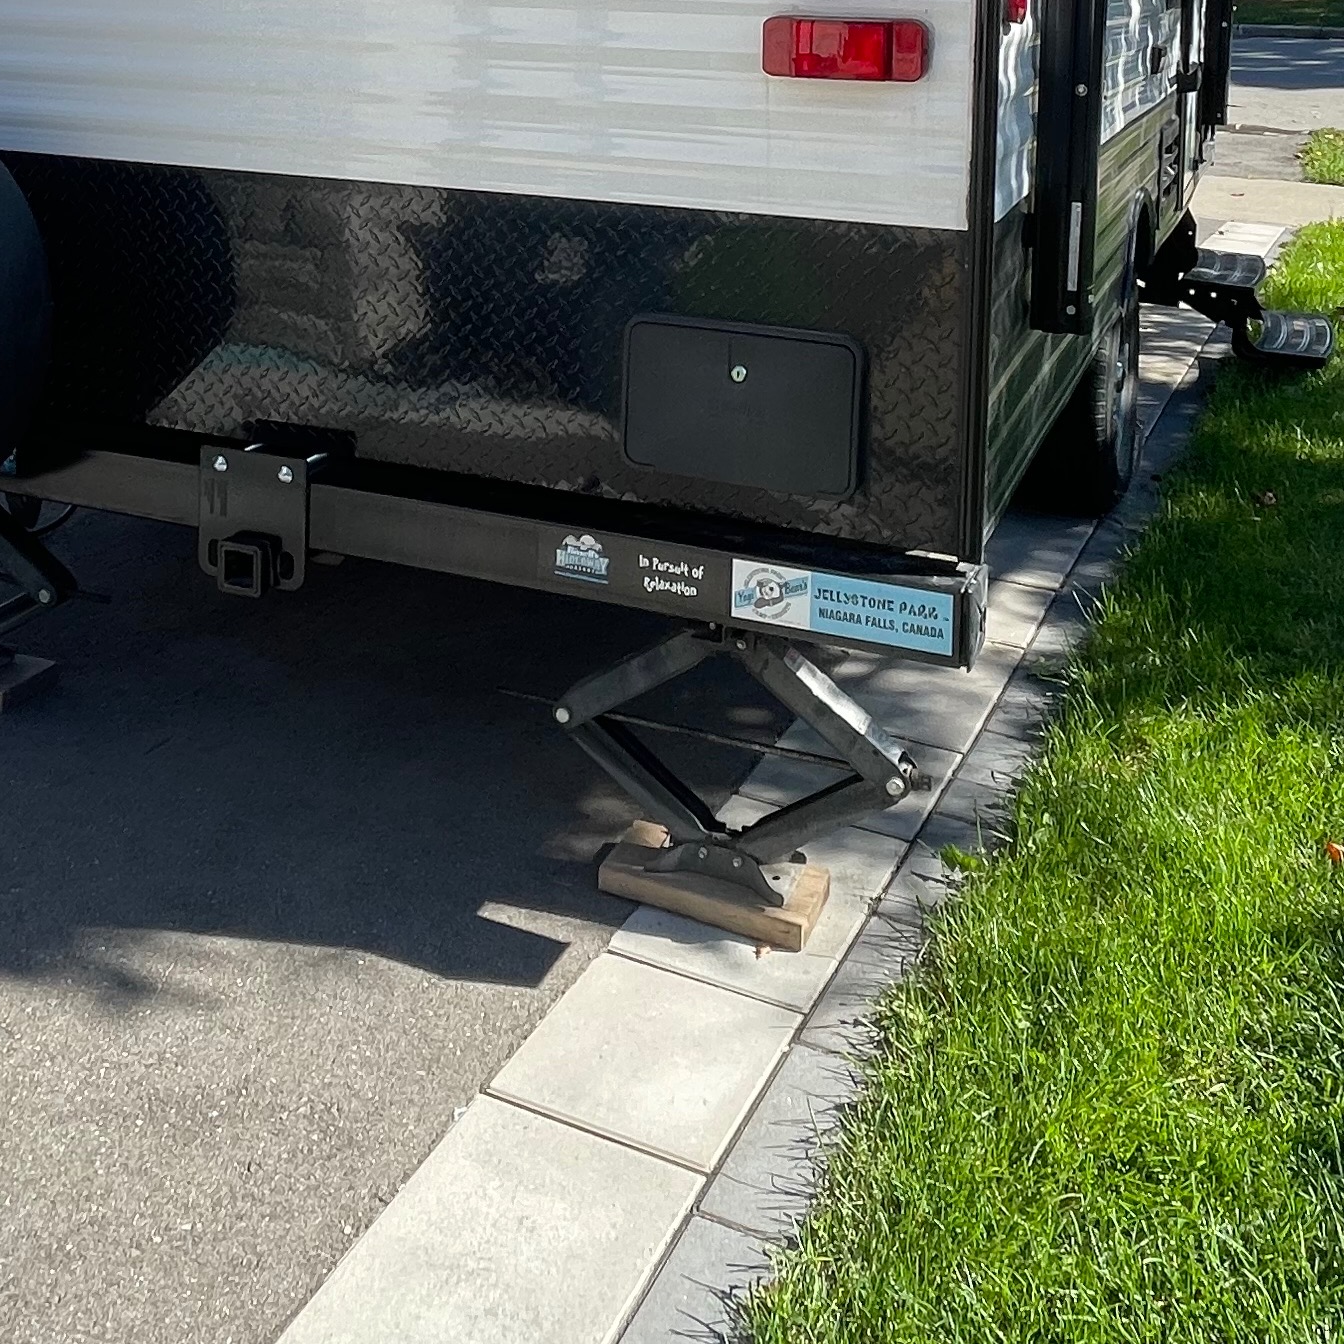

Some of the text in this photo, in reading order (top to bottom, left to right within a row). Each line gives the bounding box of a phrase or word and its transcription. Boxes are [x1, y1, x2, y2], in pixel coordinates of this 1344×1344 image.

[638, 554, 705, 580] In Pursuit of
[643, 576, 698, 596] Relaxation
[813, 588, 895, 611] JELLYSTONE
[899, 601, 939, 620] PARK
[818, 607, 945, 640] NIAGARA FALLS, CANADA
